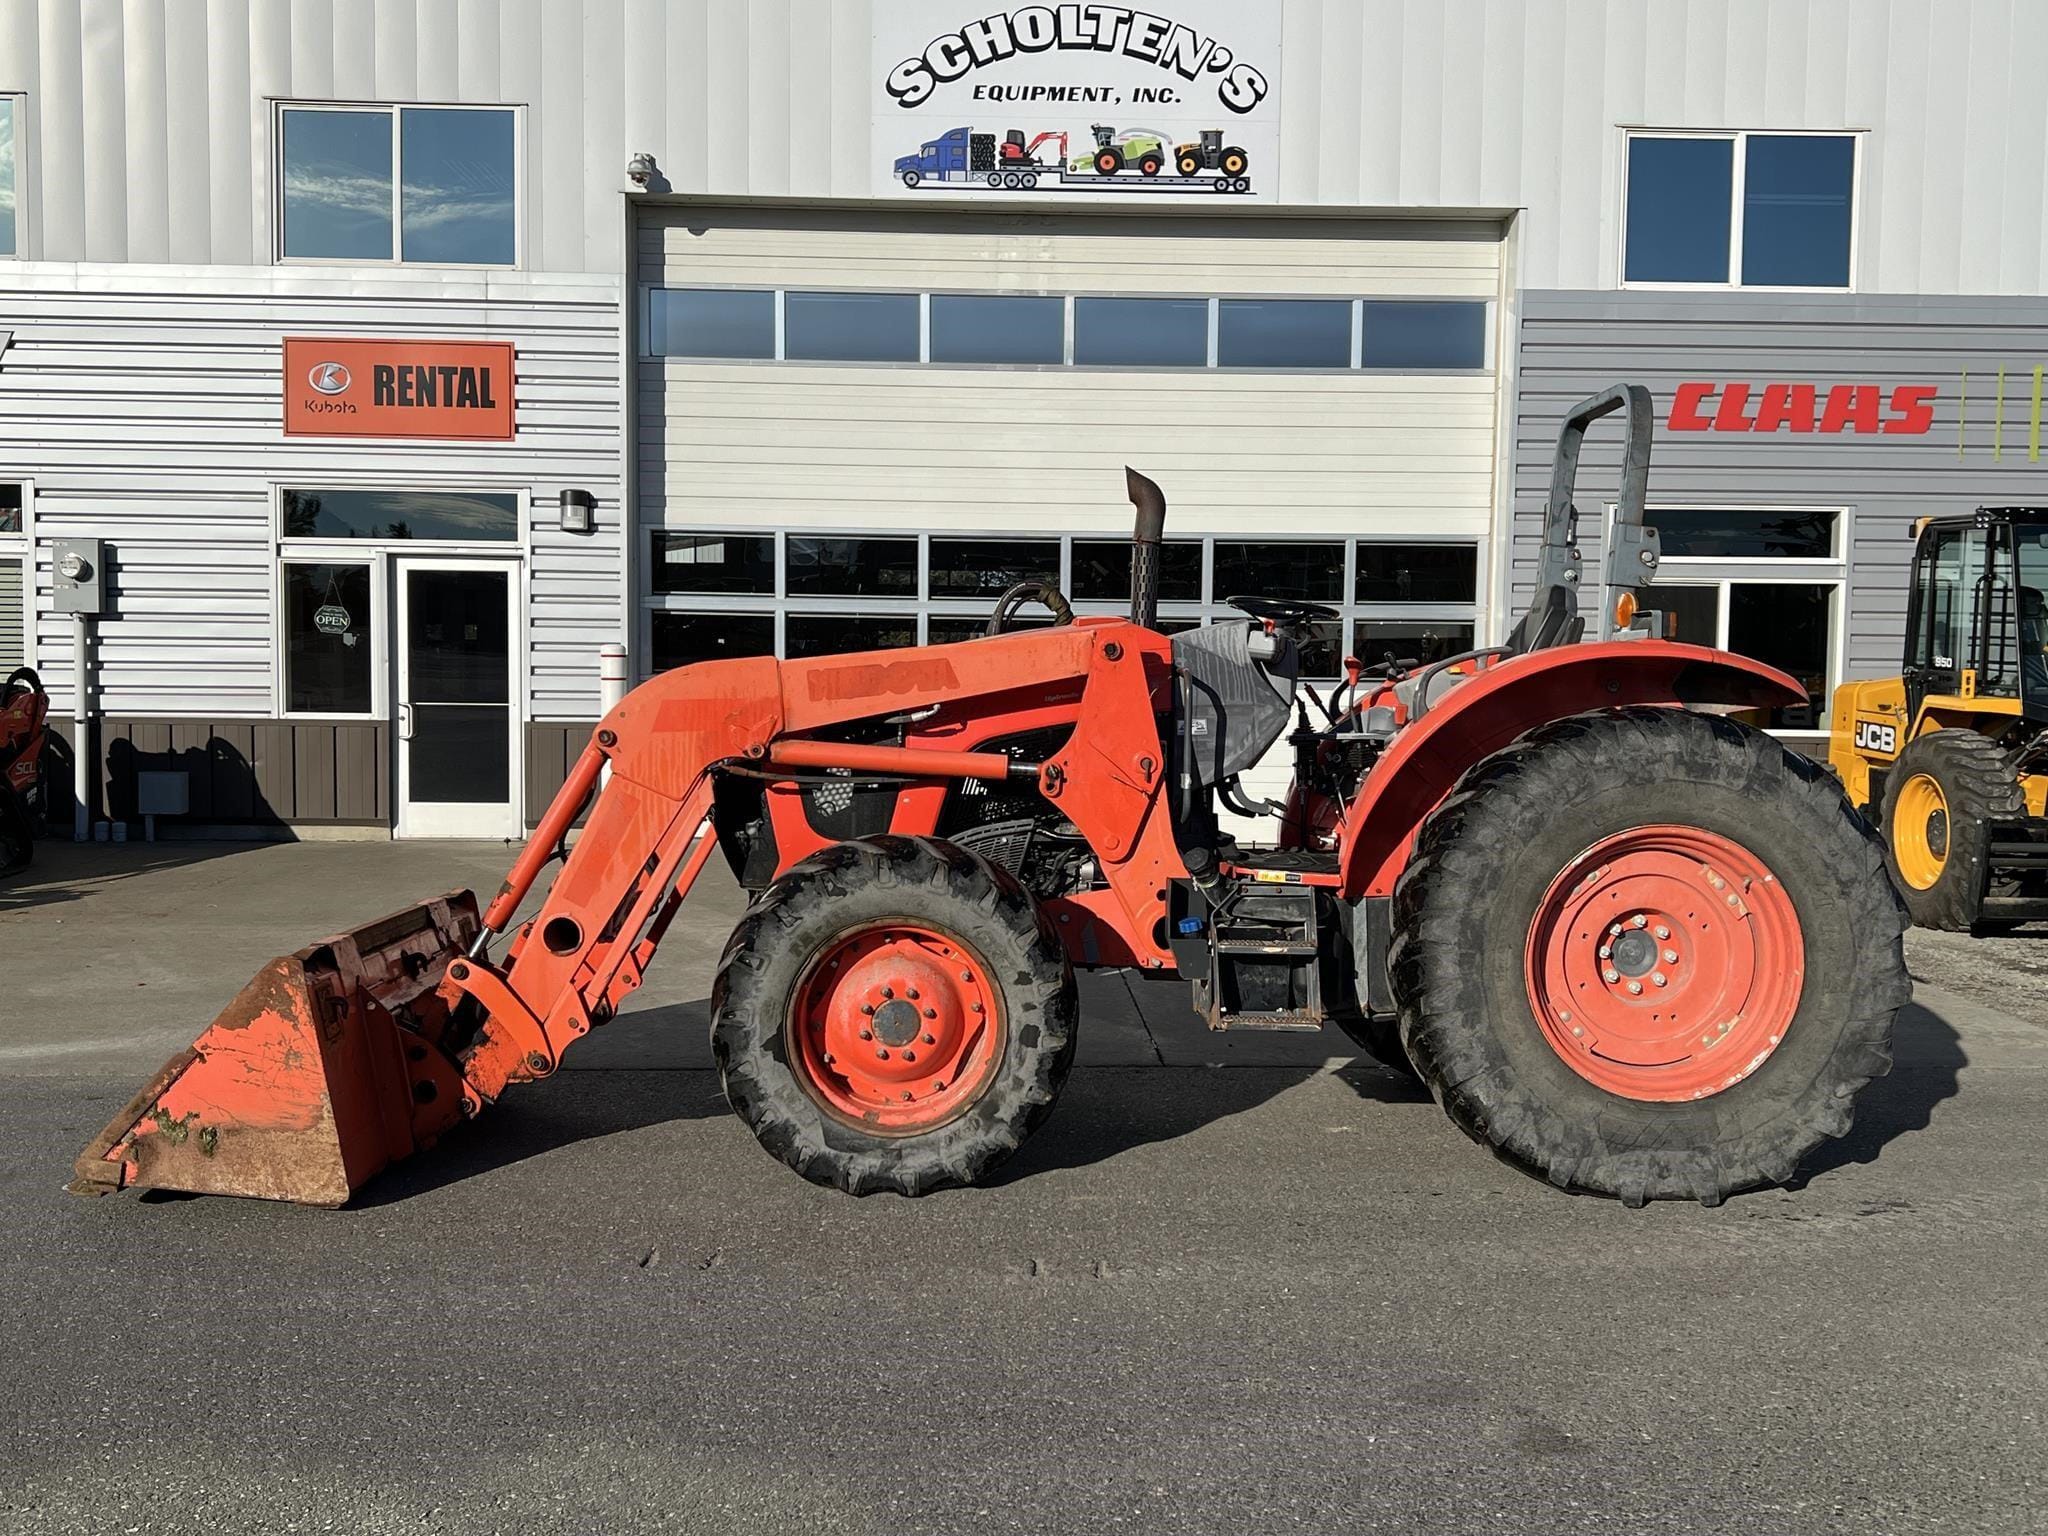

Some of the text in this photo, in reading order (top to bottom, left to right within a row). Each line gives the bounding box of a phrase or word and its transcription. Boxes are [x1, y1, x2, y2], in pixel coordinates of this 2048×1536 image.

[886, 4, 1268, 114] SCHOLTEN'S
[973, 85, 1182, 105] EQUIPMENT, INC.
[374, 364, 496, 409] RENTAL
[304, 400, 357, 414] Kubota
[1667, 383, 1938, 434] CLAAS
[316, 615, 348, 626] OPEN
[1935, 657, 1953, 668] 950
[1855, 722, 1895, 753] JCB
